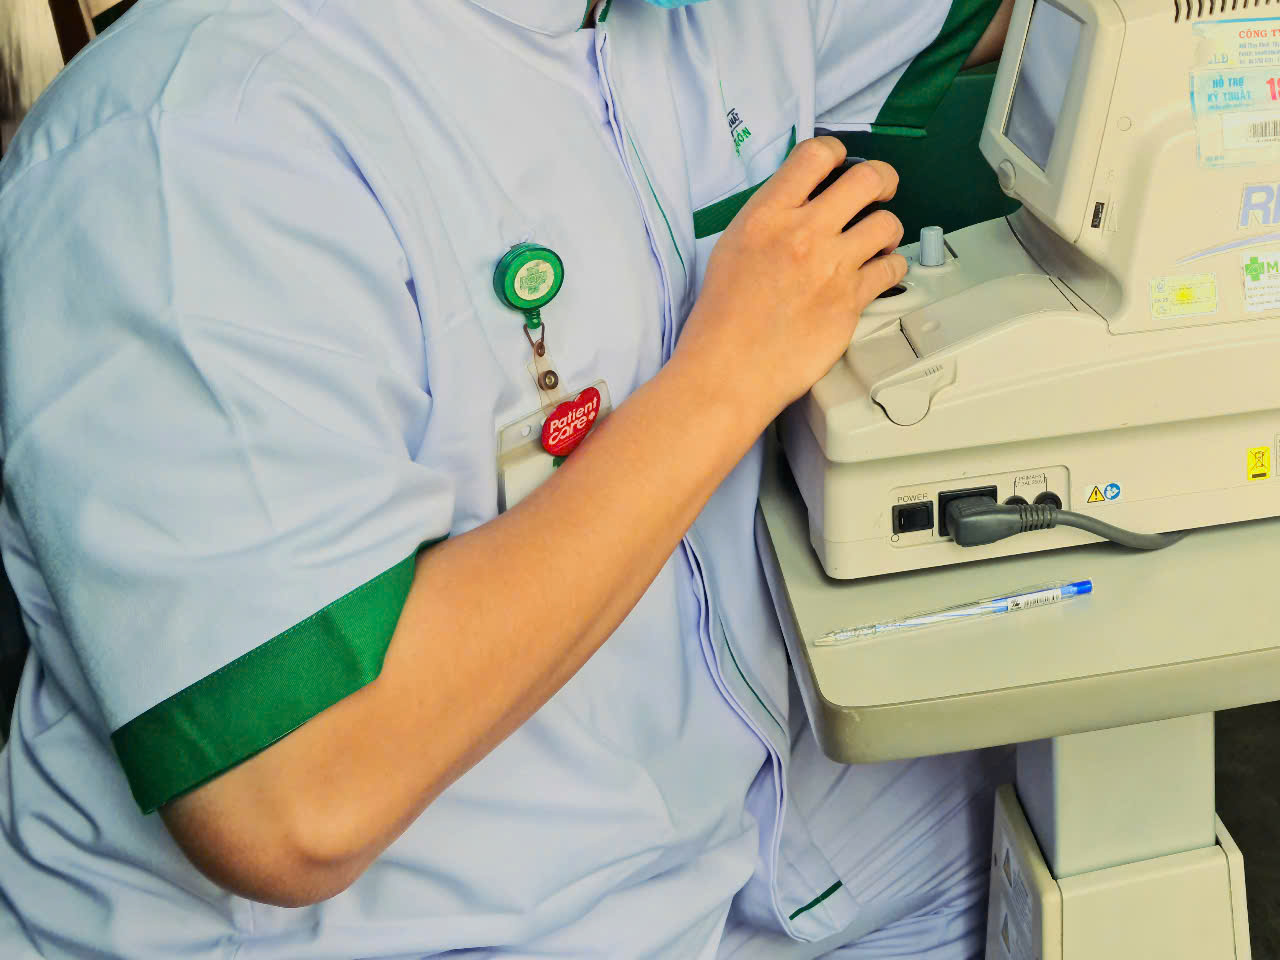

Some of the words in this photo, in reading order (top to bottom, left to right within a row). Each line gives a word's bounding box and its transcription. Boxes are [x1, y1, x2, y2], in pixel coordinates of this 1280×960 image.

[1238, 28, 1268, 39] CÔNG
[550, 396, 598, 434] Patient
[897, 492, 928, 503] POWER
